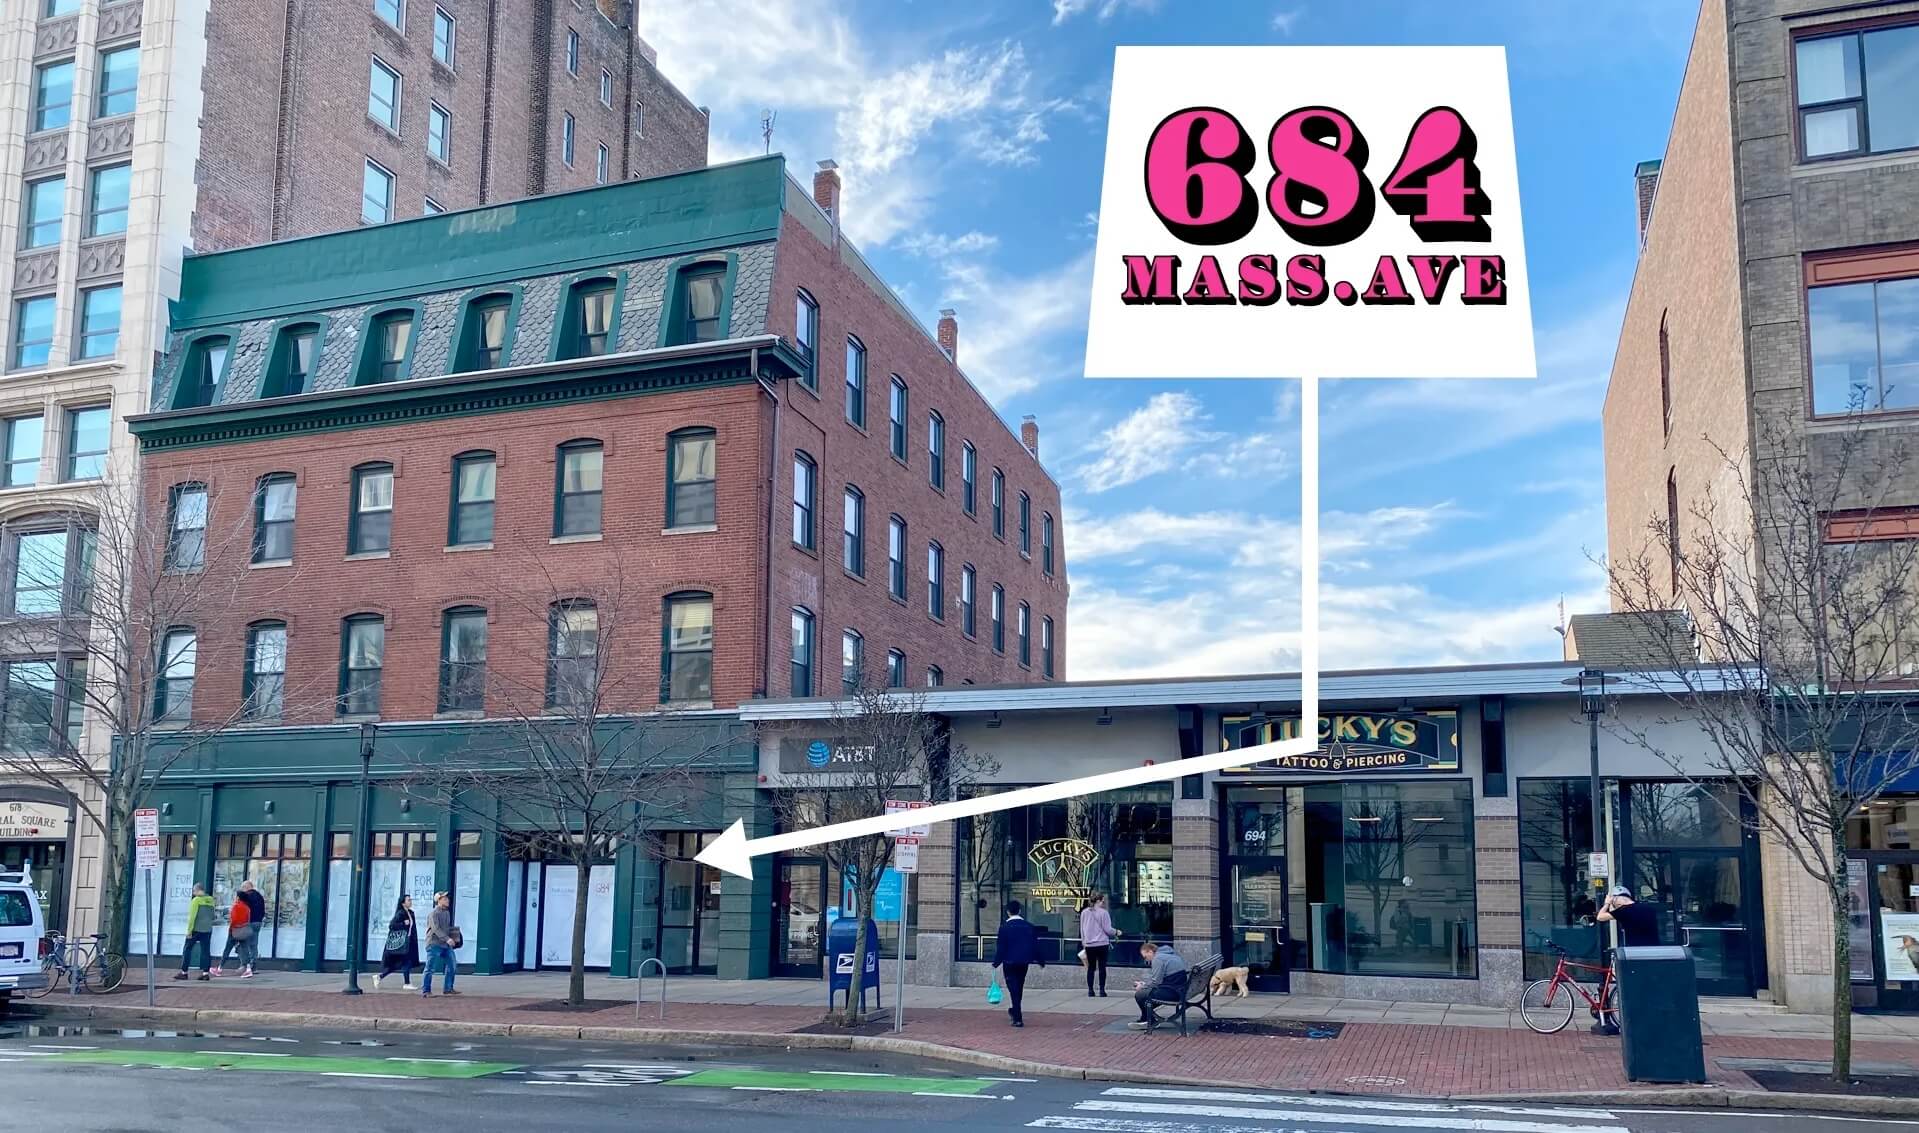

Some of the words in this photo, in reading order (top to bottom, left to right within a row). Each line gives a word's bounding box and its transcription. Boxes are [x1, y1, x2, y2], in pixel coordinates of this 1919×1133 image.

[832, 745, 876, 763] AT&T
[1276, 755, 1329, 769] TATTOO
[1332, 757, 1342, 770] &
[1346, 752, 1407, 768] PIERCING
[9, 802, 22, 812] 678
[21, 815, 57, 829] SQUARE
[1244, 830, 1266, 841] 694
[1034, 842, 1093, 862] LUCKY'S
[175, 874, 191, 885] FOR
[414, 875, 432, 886] FOR
[1032, 888, 1056, 896] TATTOO
